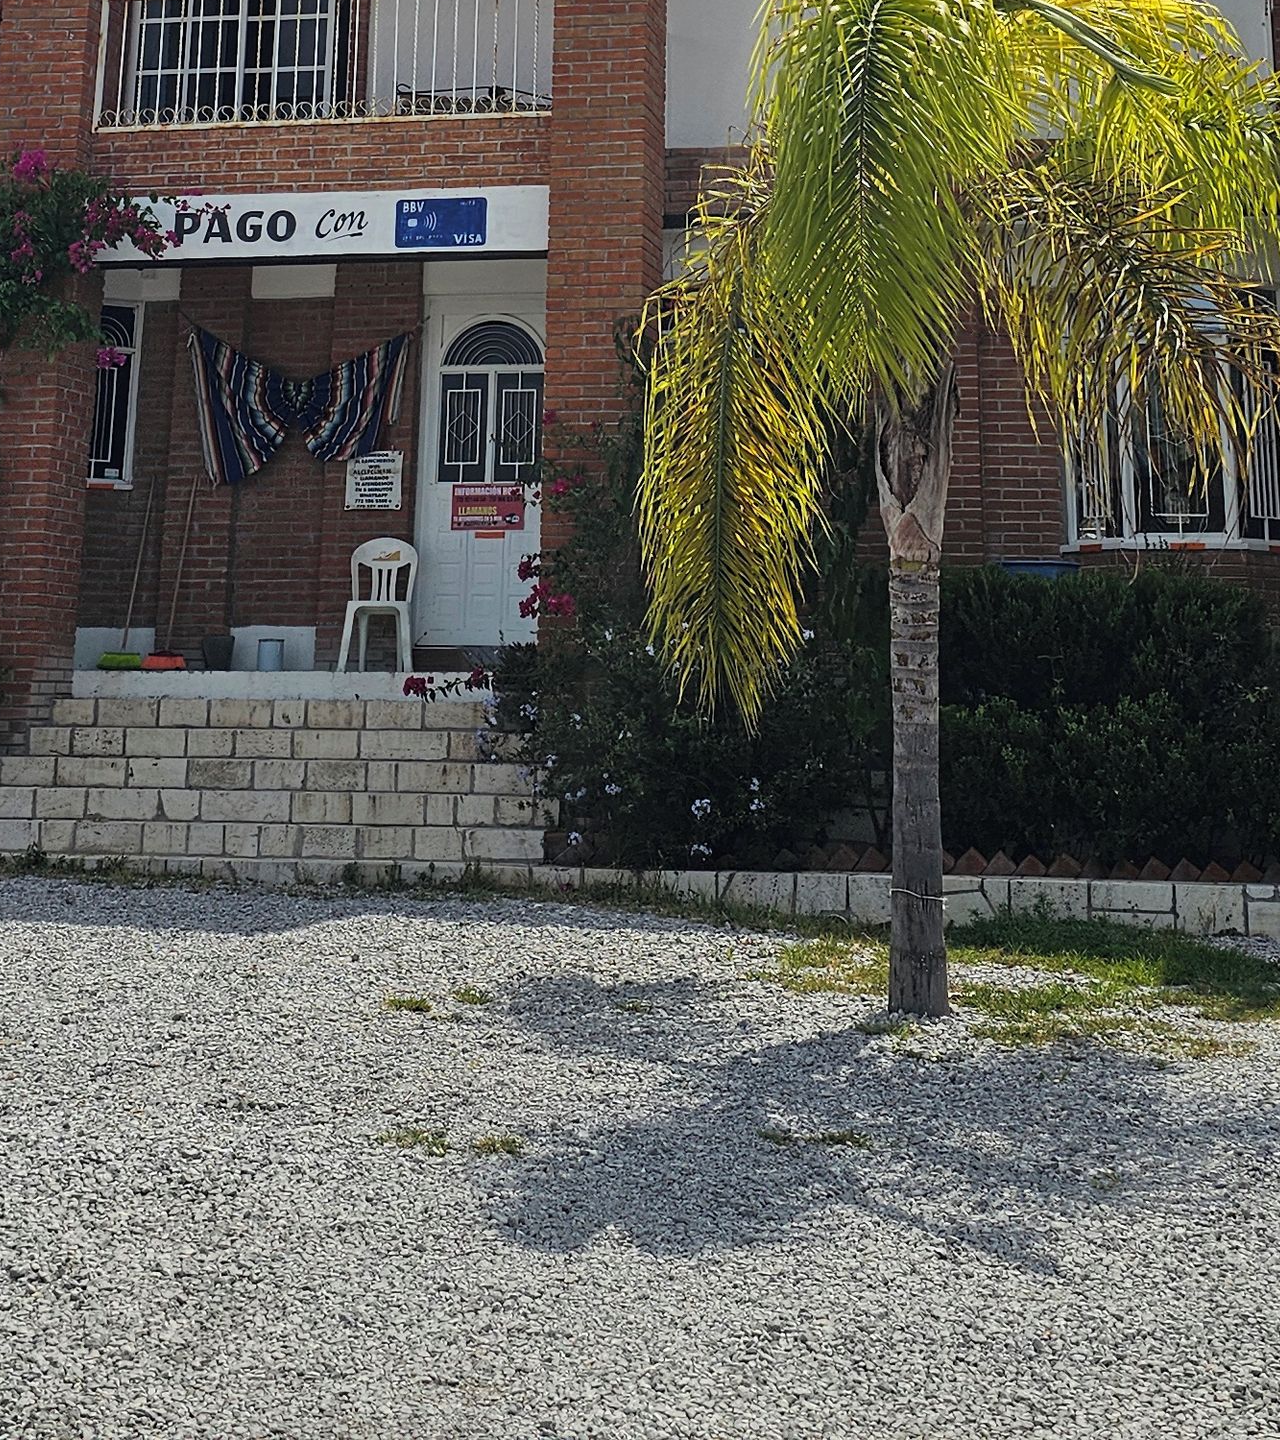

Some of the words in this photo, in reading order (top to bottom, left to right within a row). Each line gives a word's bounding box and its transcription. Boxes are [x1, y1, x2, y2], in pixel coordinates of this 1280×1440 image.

[402, 201, 425, 213] BBV
[174, 209, 296, 244] PAGO
[315, 208, 369, 241] Con
[453, 232, 483, 244] VISA
